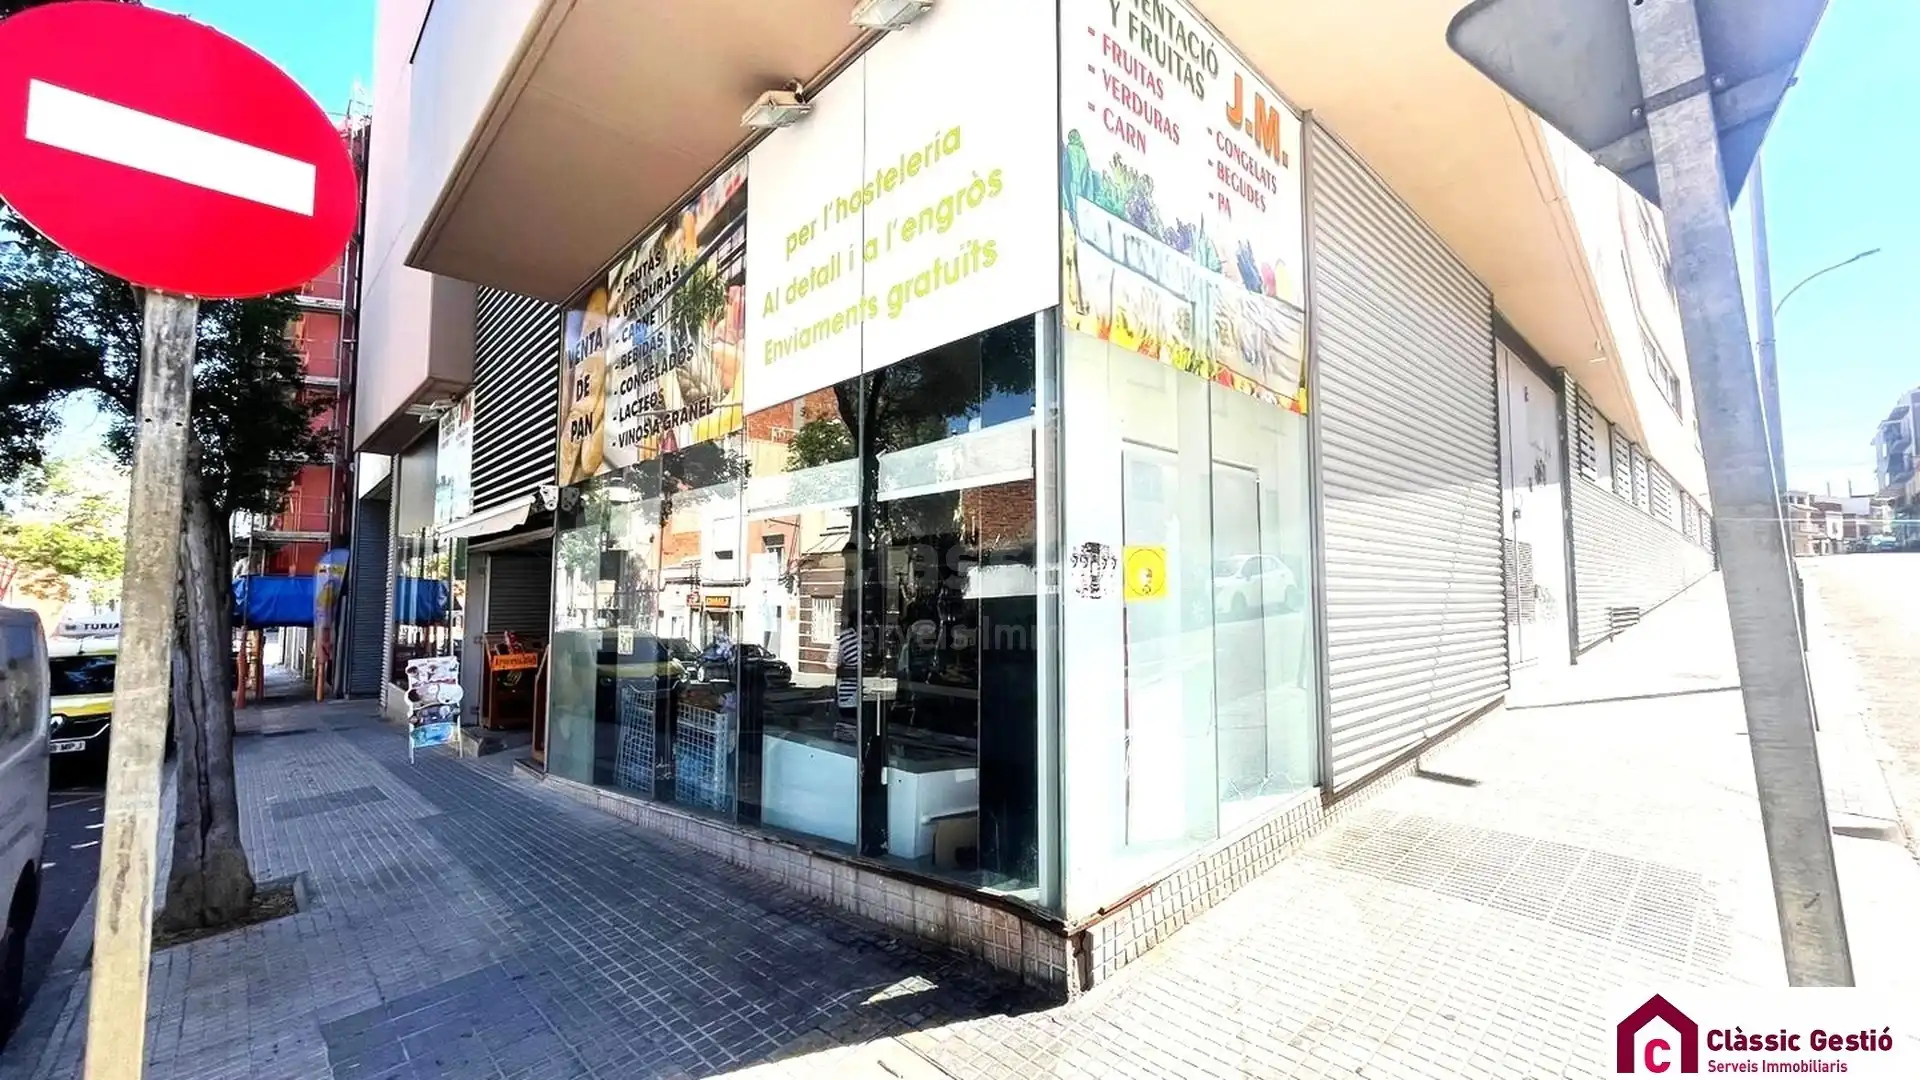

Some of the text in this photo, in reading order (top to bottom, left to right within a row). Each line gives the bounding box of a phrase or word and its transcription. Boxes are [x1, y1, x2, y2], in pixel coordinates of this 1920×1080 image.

[1109, 0, 1205, 101] Y FRUITAS
[1134, 0, 1219, 79] ENTACIÓ
[1102, 33, 1164, 100] FRUITAS
[1102, 69, 1180, 146] VERDURAS
[1103, 108, 1147, 155] CARN
[1226, 72, 1289, 169] J.M.
[1216, 130, 1277, 194] CONGELATS
[1216, 161, 1266, 213] BEGUDES
[1217, 192, 1232, 222] PA
[762, 168, 1004, 318] Al detall i a l'engròs
[785, 217, 817, 261] per
[623, 251, 661, 292] FRUTAS
[623, 264, 679, 317] VERDURAS
[622, 309, 656, 343] CARNE
[764, 239, 998, 366] Enviaments gratuïts
[568, 327, 603, 369] VENTA
[620, 332, 663, 370] BEBIDAS
[620, 343, 694, 395] CONGELADOS
[576, 374, 590, 402] DE
[619, 388, 665, 422] LACTEOS
[571, 412, 593, 443] PAN
[618, 421, 649, 448] VINOS
[663, 396, 714, 430] GRANEL
